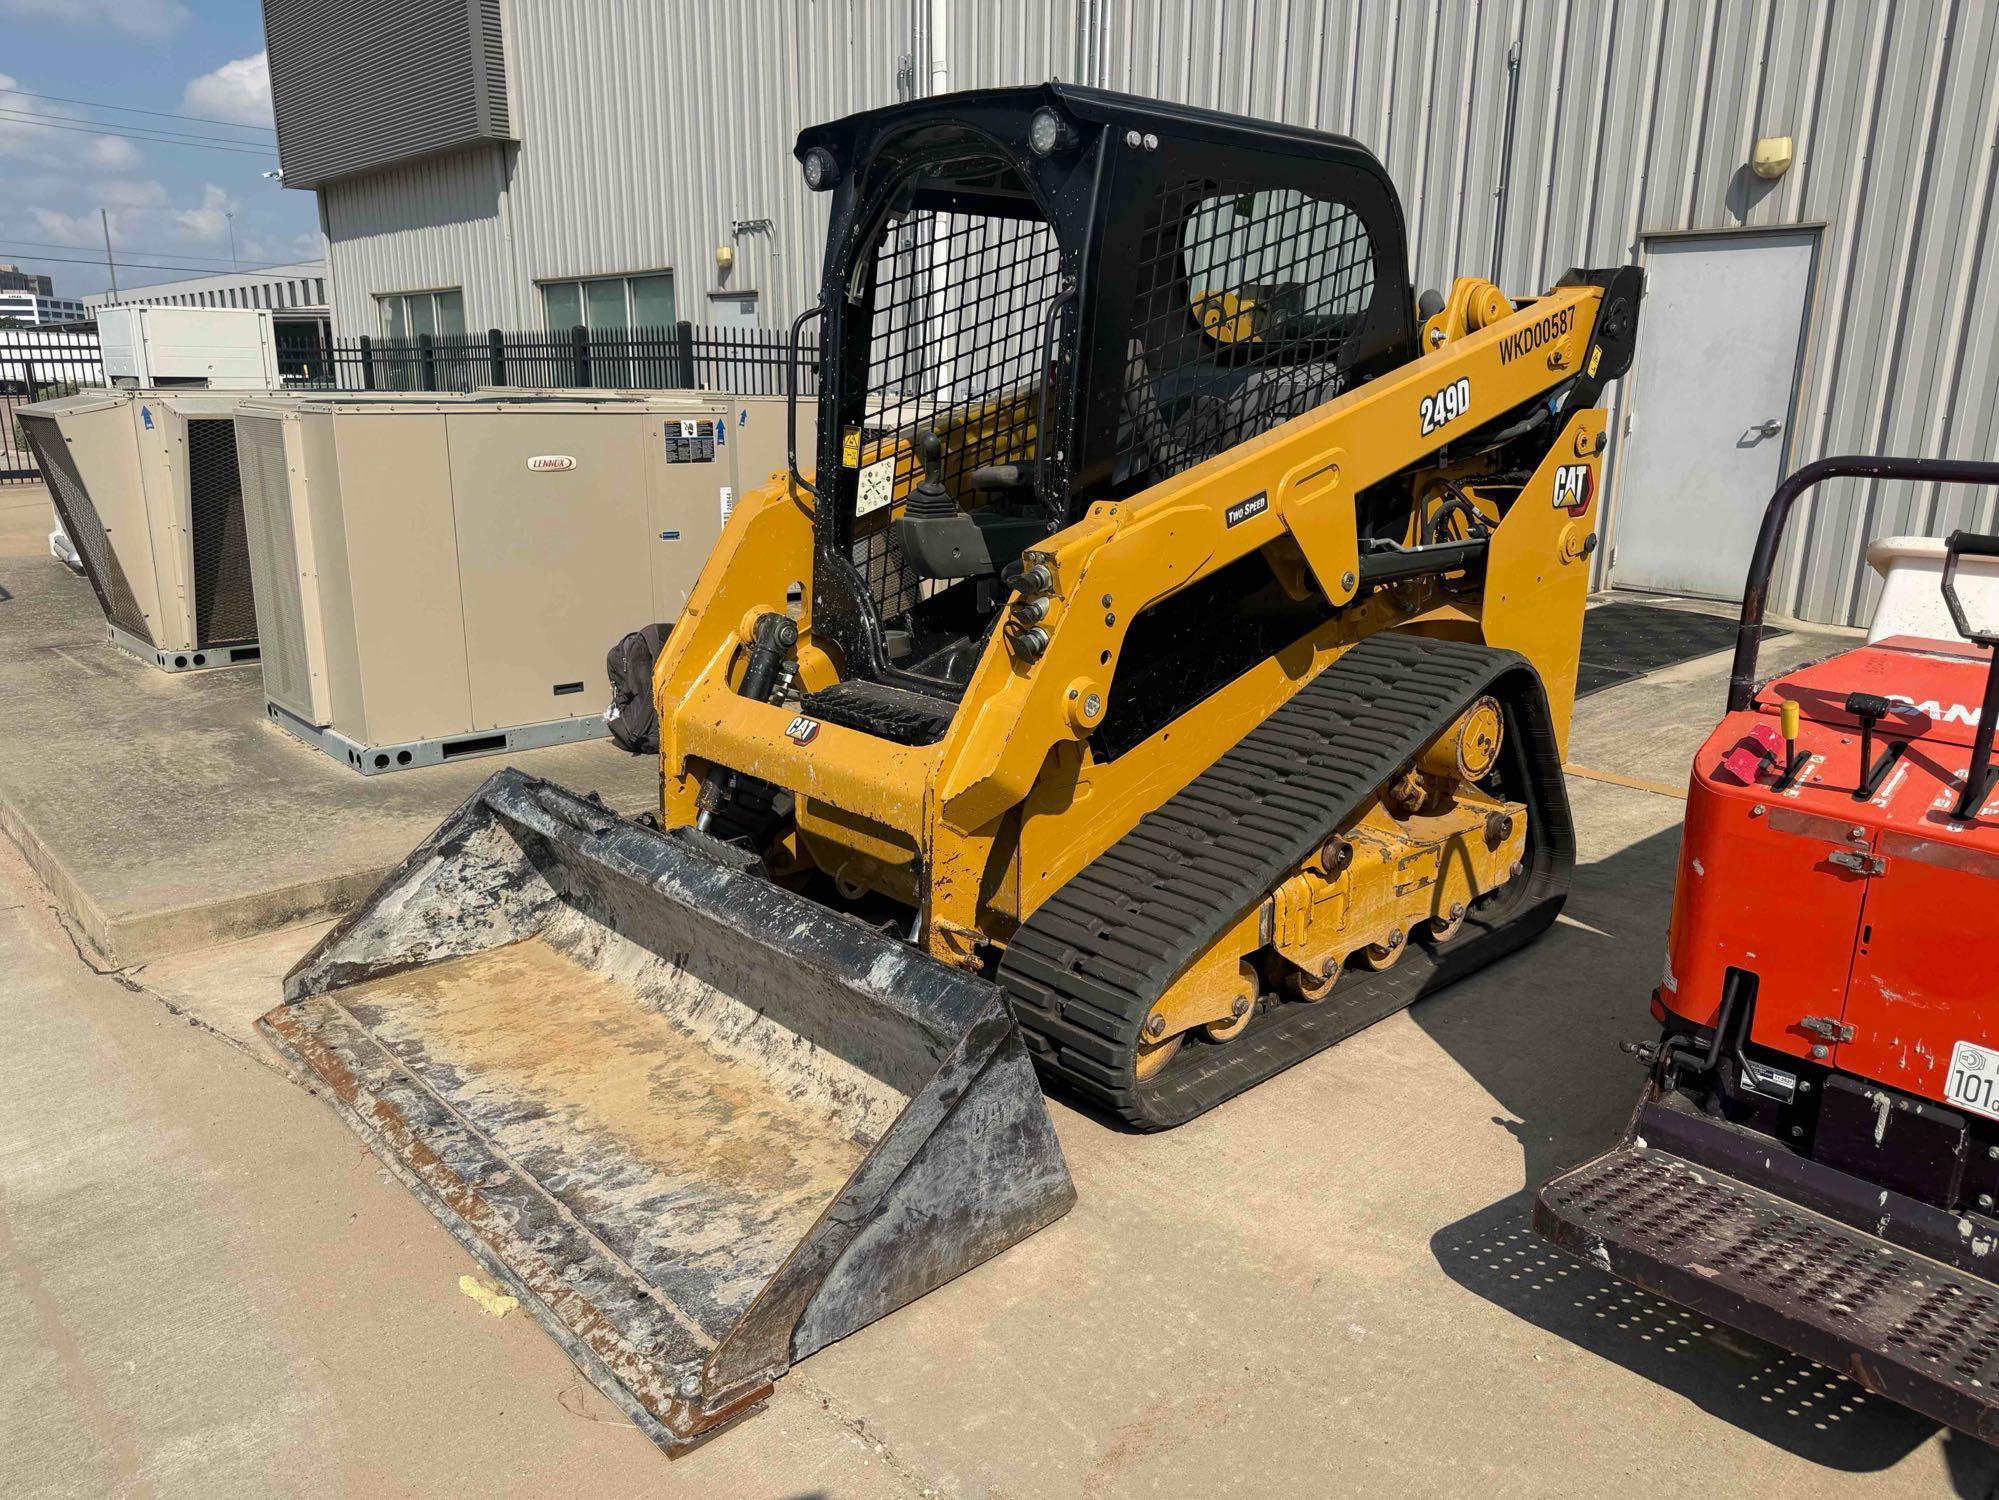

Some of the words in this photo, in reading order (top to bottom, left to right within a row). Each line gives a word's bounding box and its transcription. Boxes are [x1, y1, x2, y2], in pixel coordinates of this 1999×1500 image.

[1499, 304, 1576, 367] WKD00587
[1420, 377, 1470, 437] 249D
[533, 459, 565, 468] LENNOX
[1552, 465, 1588, 508] CAT
[785, 715, 819, 741] CAT
